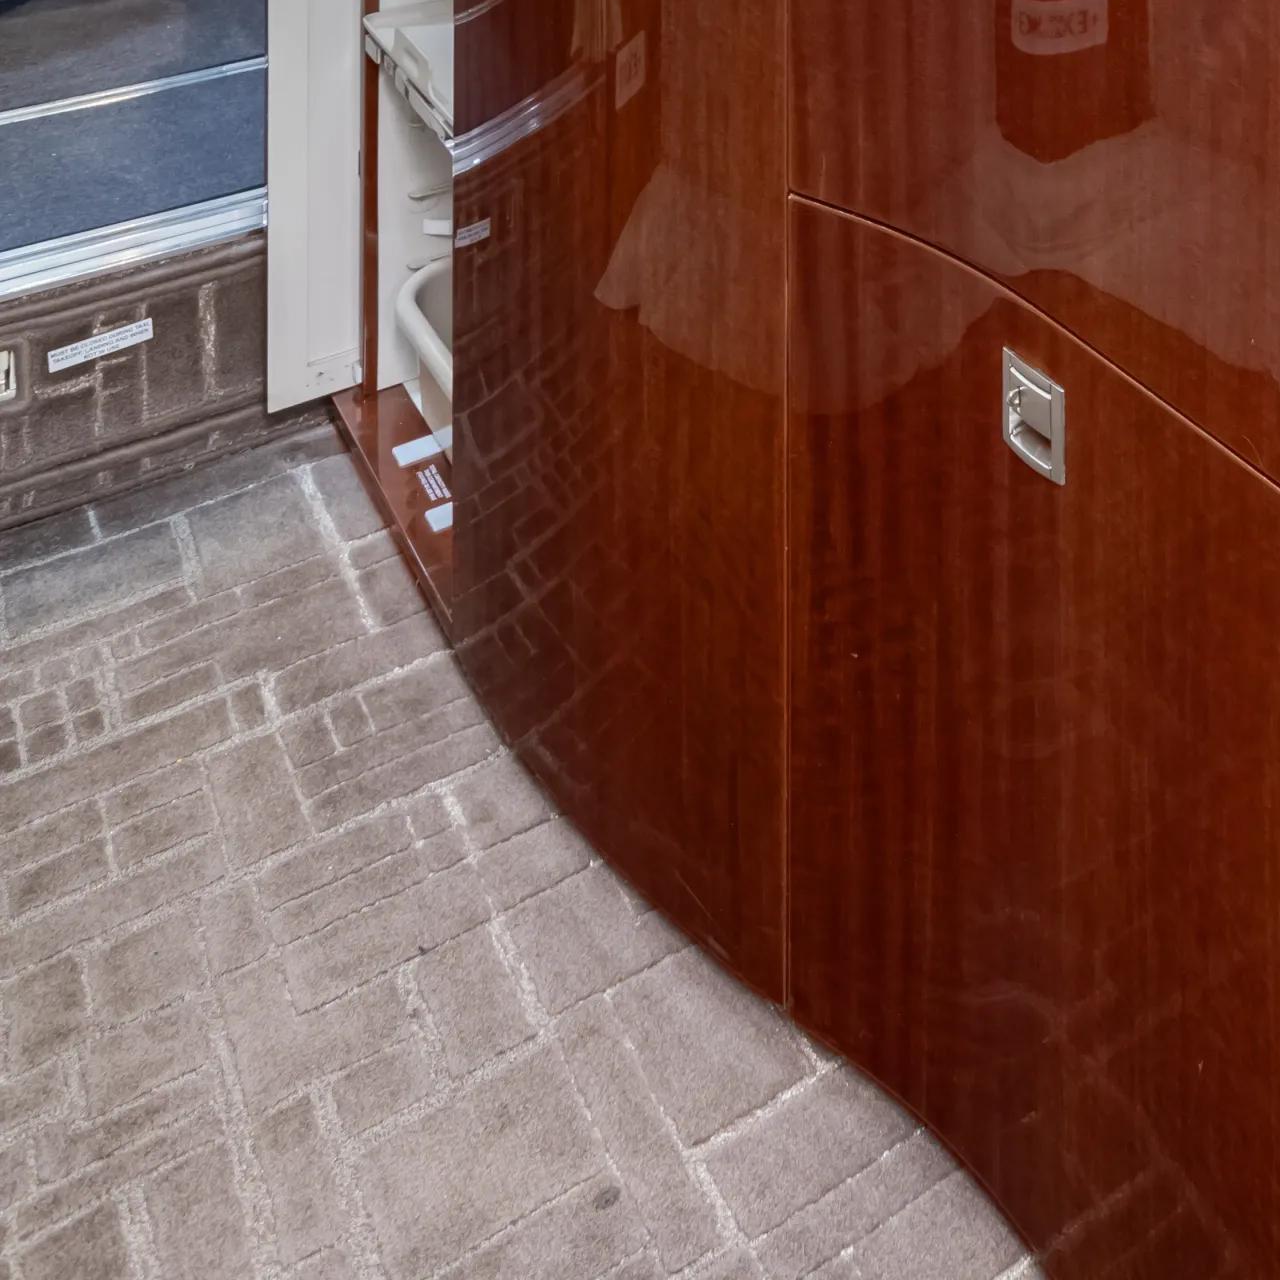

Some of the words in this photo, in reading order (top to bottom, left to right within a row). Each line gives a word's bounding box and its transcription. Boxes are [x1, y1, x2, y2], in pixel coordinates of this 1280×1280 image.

[50, 348, 69, 359] MUST
[70, 345, 80, 353] BE
[81, 335, 108, 348] CLOSED
[108, 327, 133, 340] DURING
[83, 351, 98, 360] NOT
[106, 344, 120, 352] USE
[84, 340, 114, 354] LANDING
[114, 335, 129, 344] AND
[130, 328, 149, 339] WHEN
